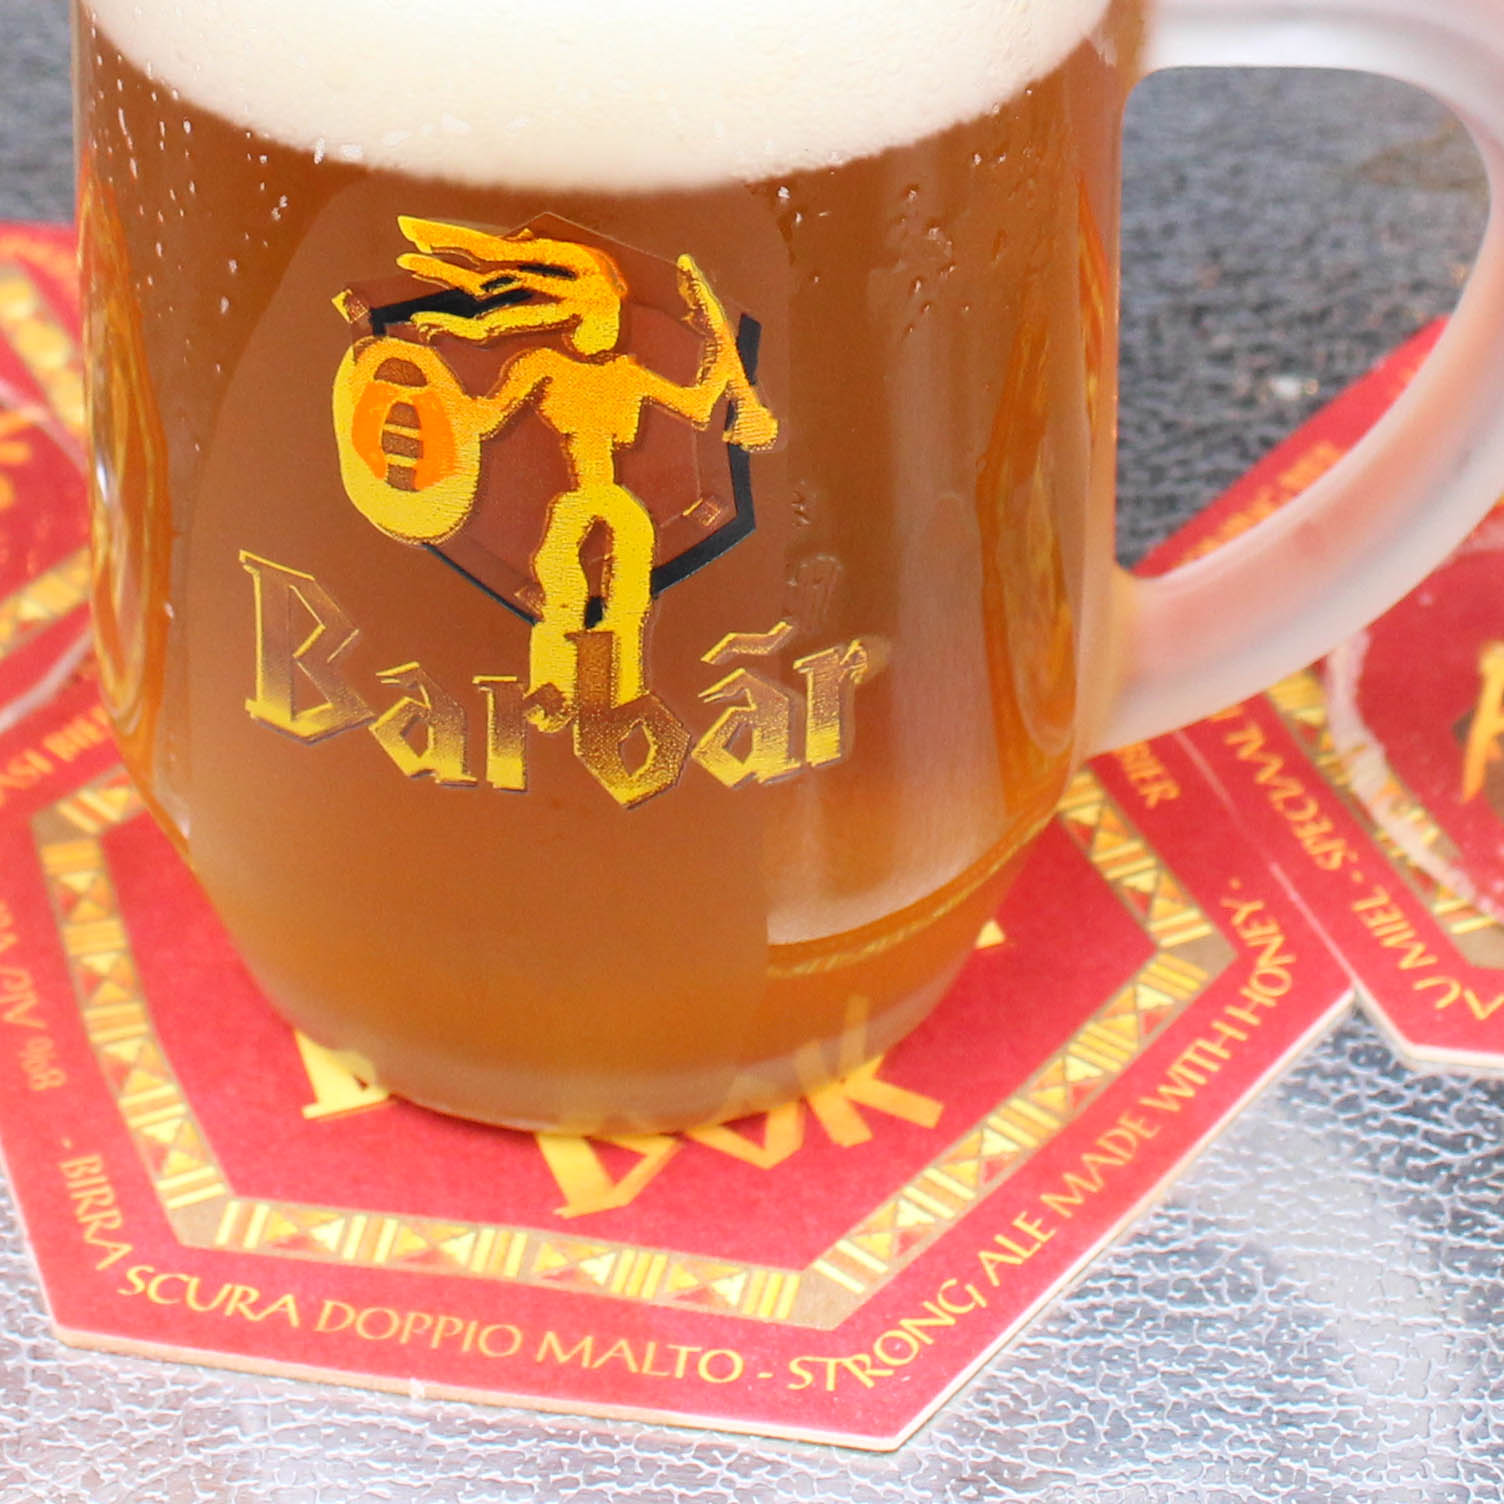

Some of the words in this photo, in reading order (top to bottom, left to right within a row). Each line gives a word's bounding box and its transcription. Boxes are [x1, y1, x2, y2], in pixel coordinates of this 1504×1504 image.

[1353, 888, 1436, 971] MIEL
[61, 1153, 133, 1272] BIRRA
[117, 1263, 302, 1328] SCURA
[314, 1300, 525, 1360] DOPPIO
[536, 1329, 744, 1384] MALTO
[787, 1279, 989, 1392] STRONG
[978, 1211, 1056, 1287] ALE
[1040, 1110, 1162, 1218] MADE
[1141, 1018, 1248, 1114] WITH
